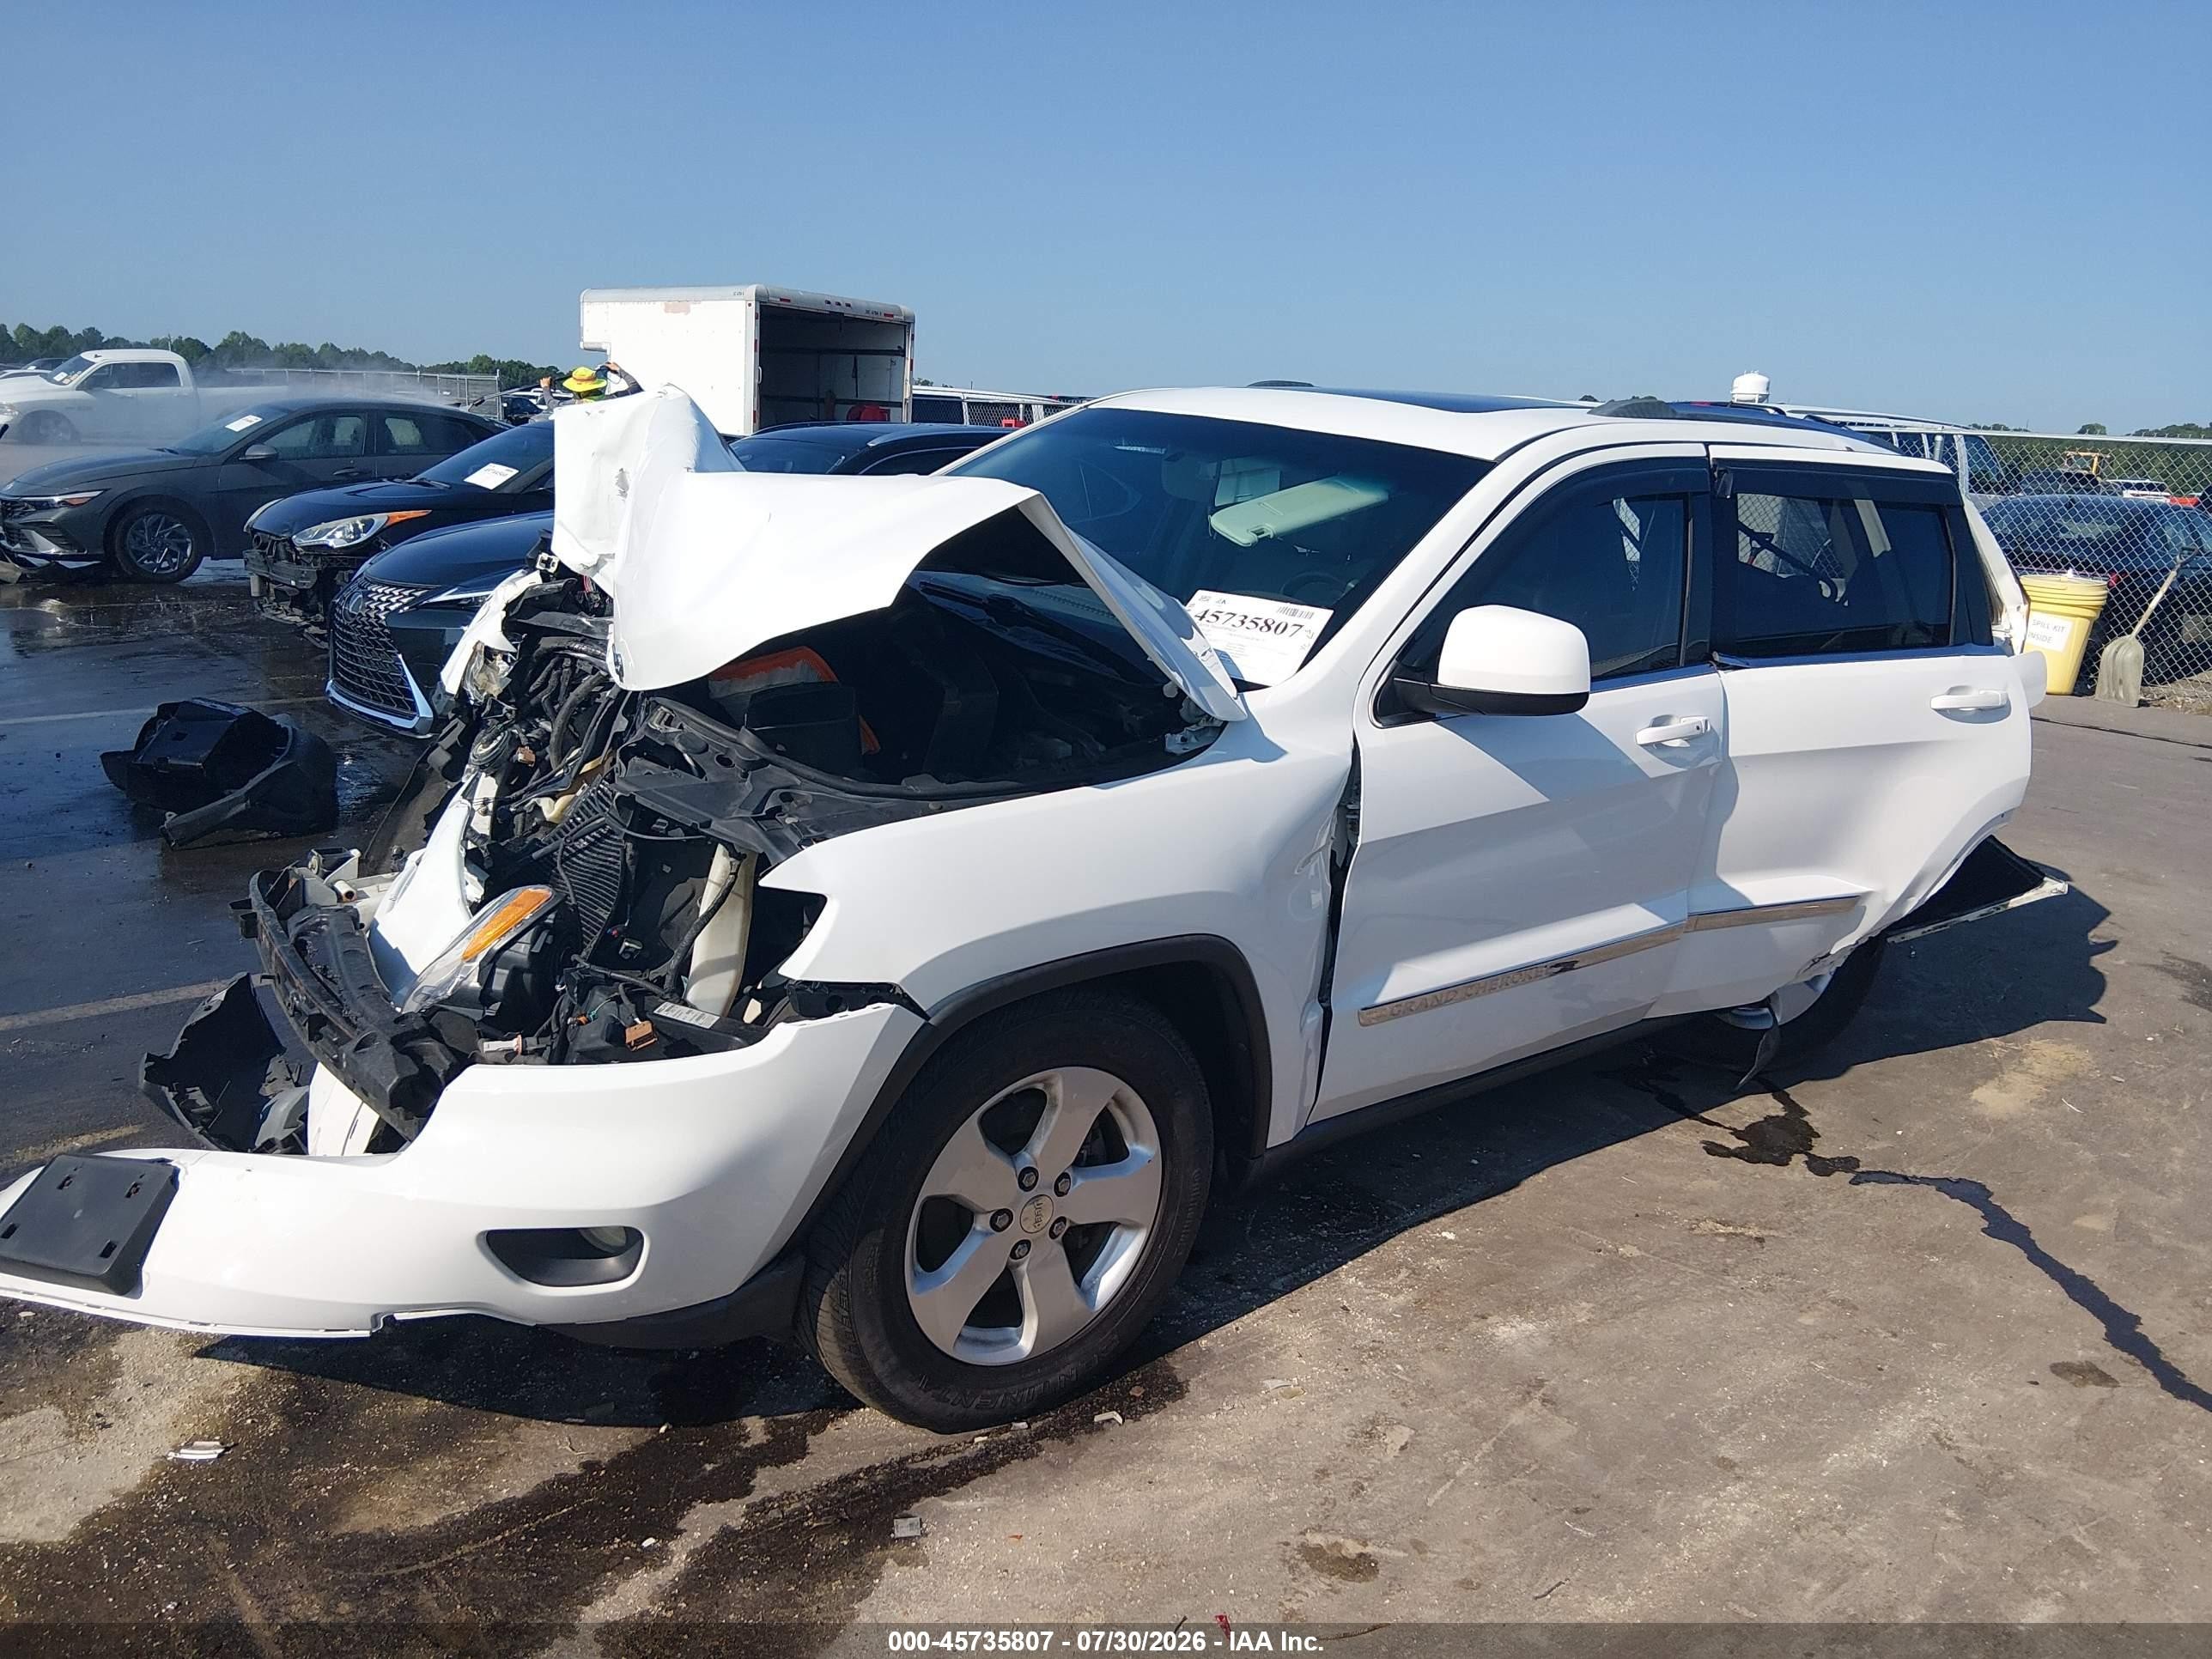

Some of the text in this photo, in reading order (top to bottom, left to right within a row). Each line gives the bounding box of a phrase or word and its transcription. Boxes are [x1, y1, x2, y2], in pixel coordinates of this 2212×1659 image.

[1194, 609, 1304, 637] 45735807
[2033, 619, 2051, 630] SPILL
[2027, 631, 2053, 643] INSIDE
[1391, 991, 1458, 1017] GRAND
